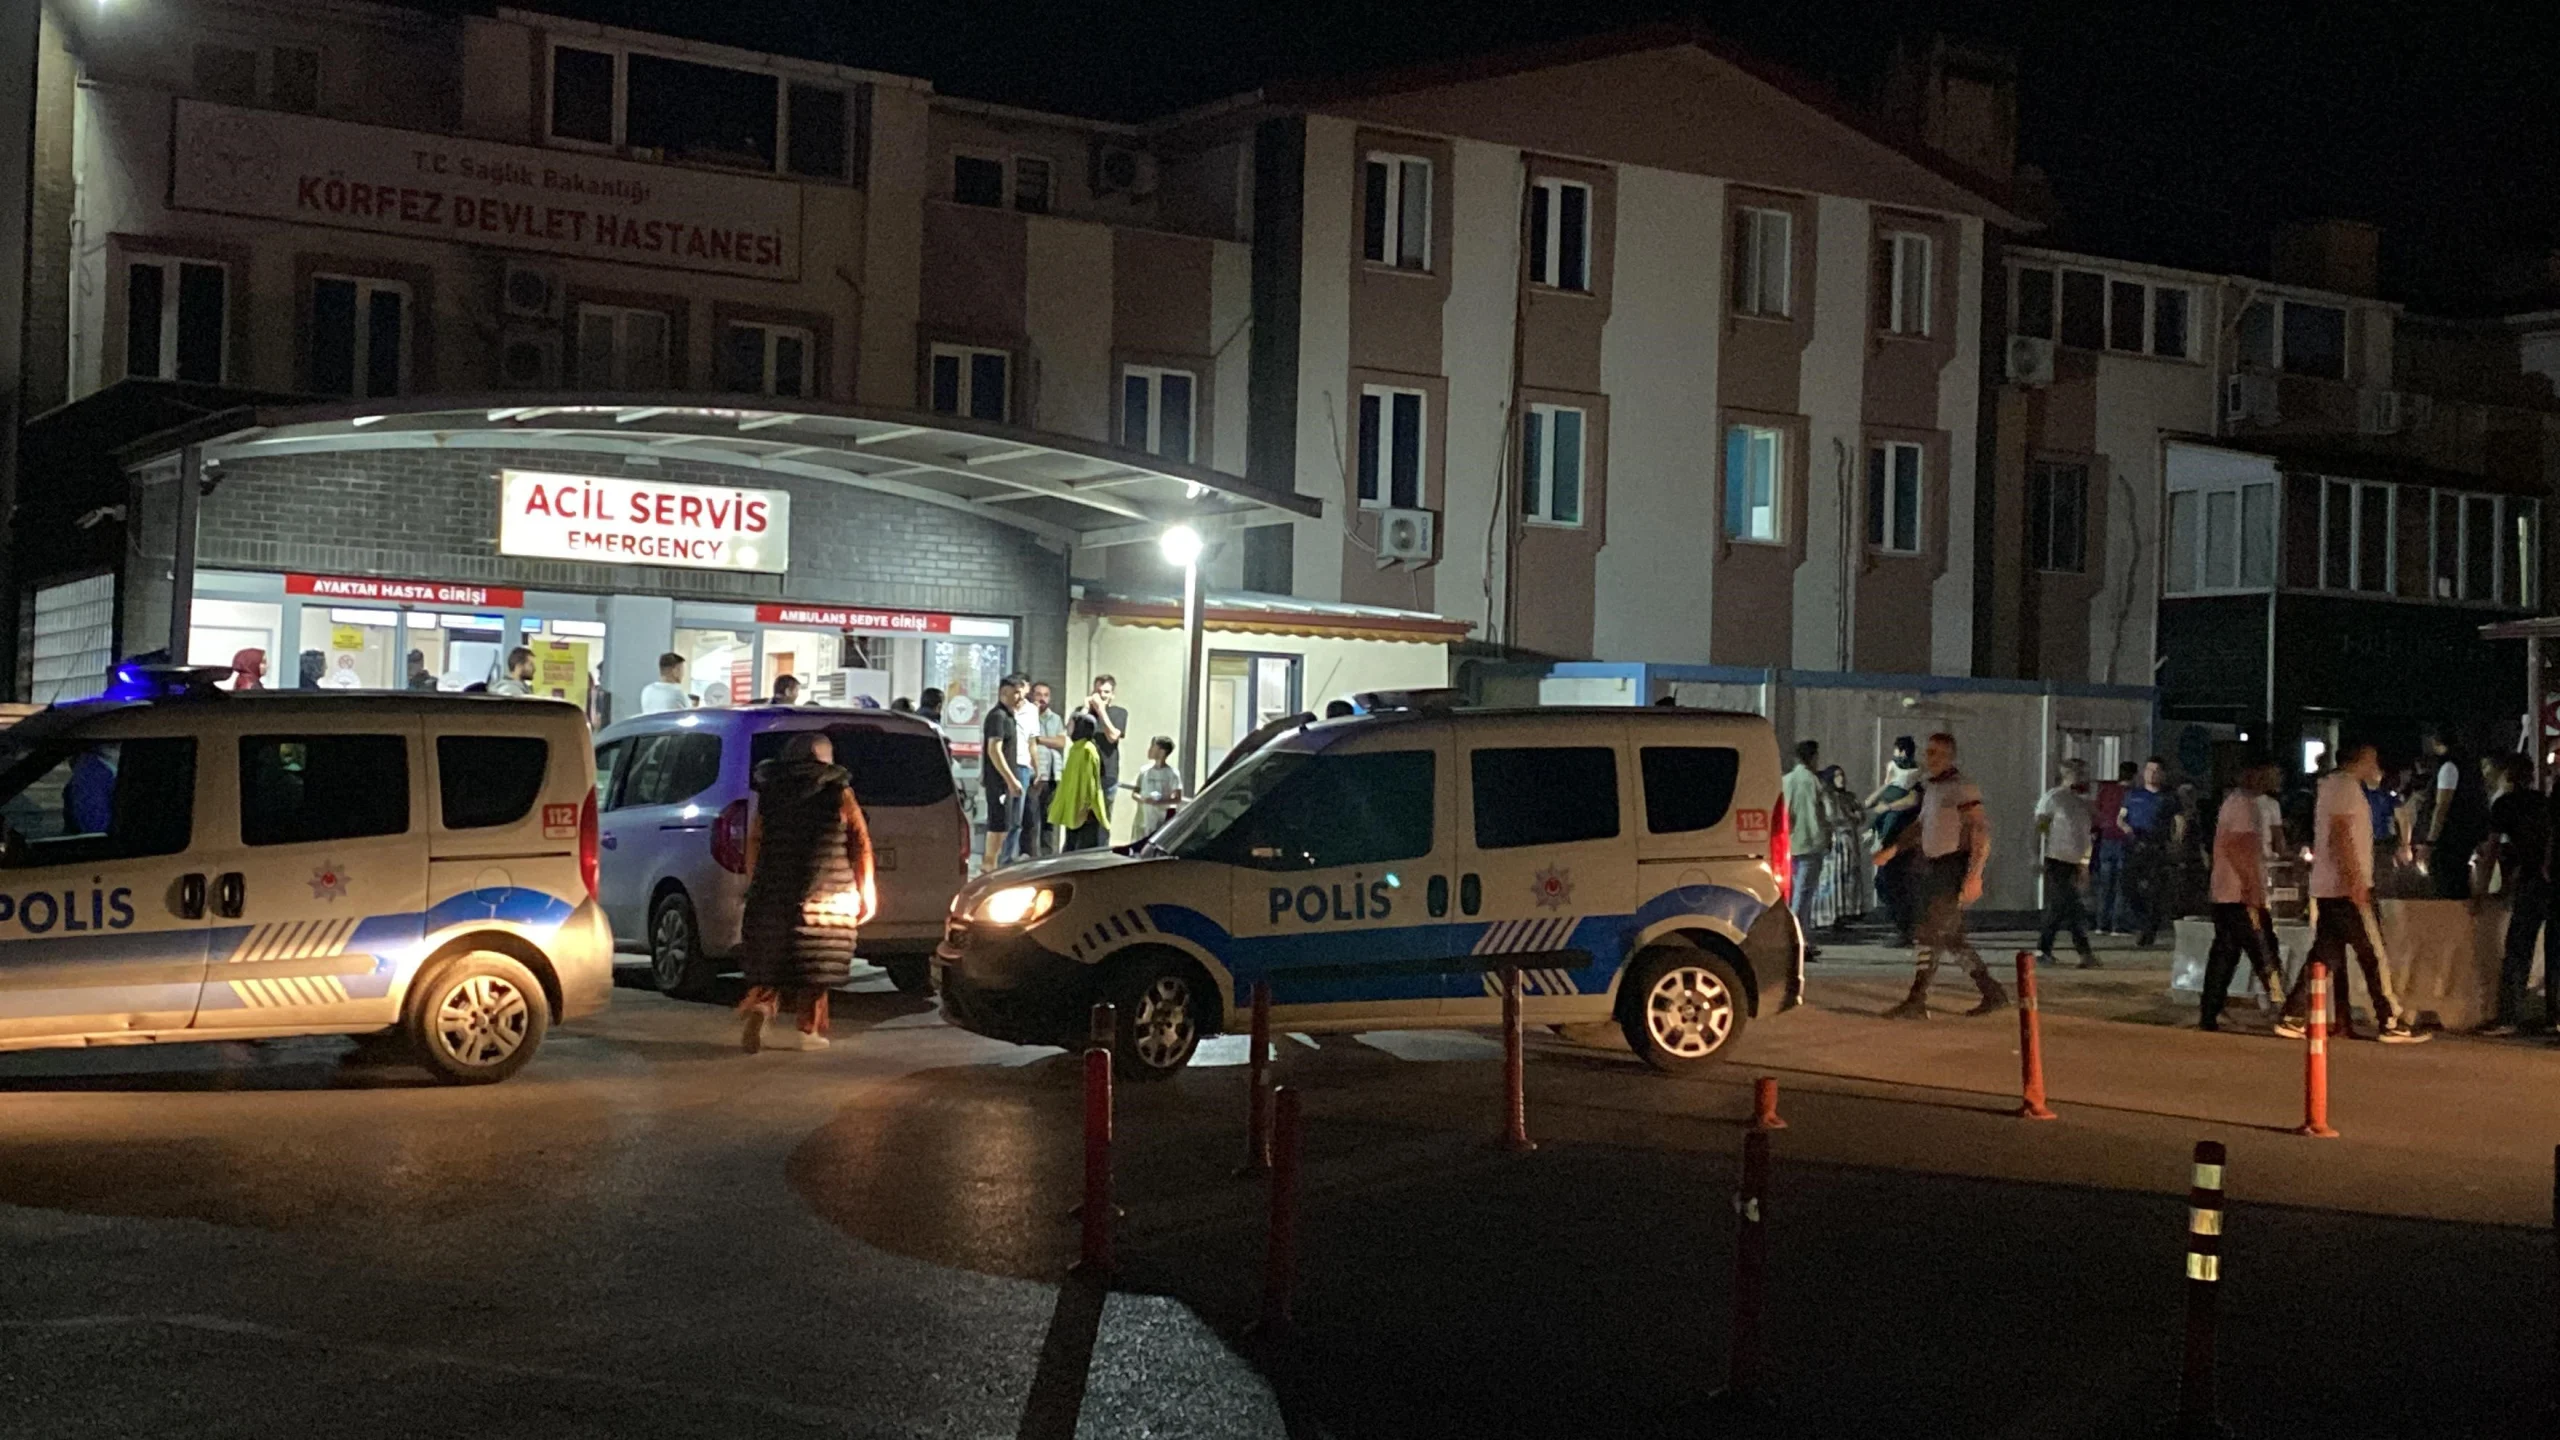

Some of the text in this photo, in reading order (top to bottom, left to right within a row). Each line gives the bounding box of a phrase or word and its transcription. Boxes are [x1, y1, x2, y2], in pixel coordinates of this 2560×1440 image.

[459, 157, 535, 189] Sağlık
[543, 169, 653, 206] Bakanlığı
[296, 168, 783, 266] KÖRFEZ DEVLET HASTANESİ
[525, 480, 768, 533] ACİL SERVİS
[567, 530, 724, 561] EMERGENCY
[313, 580, 487, 606] AYAKTAN HASTA GİRİŞİ
[779, 610, 928, 632] AMBULANS SEDYE GİRİŞİ
[548, 807, 574, 825] 112
[1740, 811, 1766, 830] 112
[1269, 872, 1392, 924] POLİS
